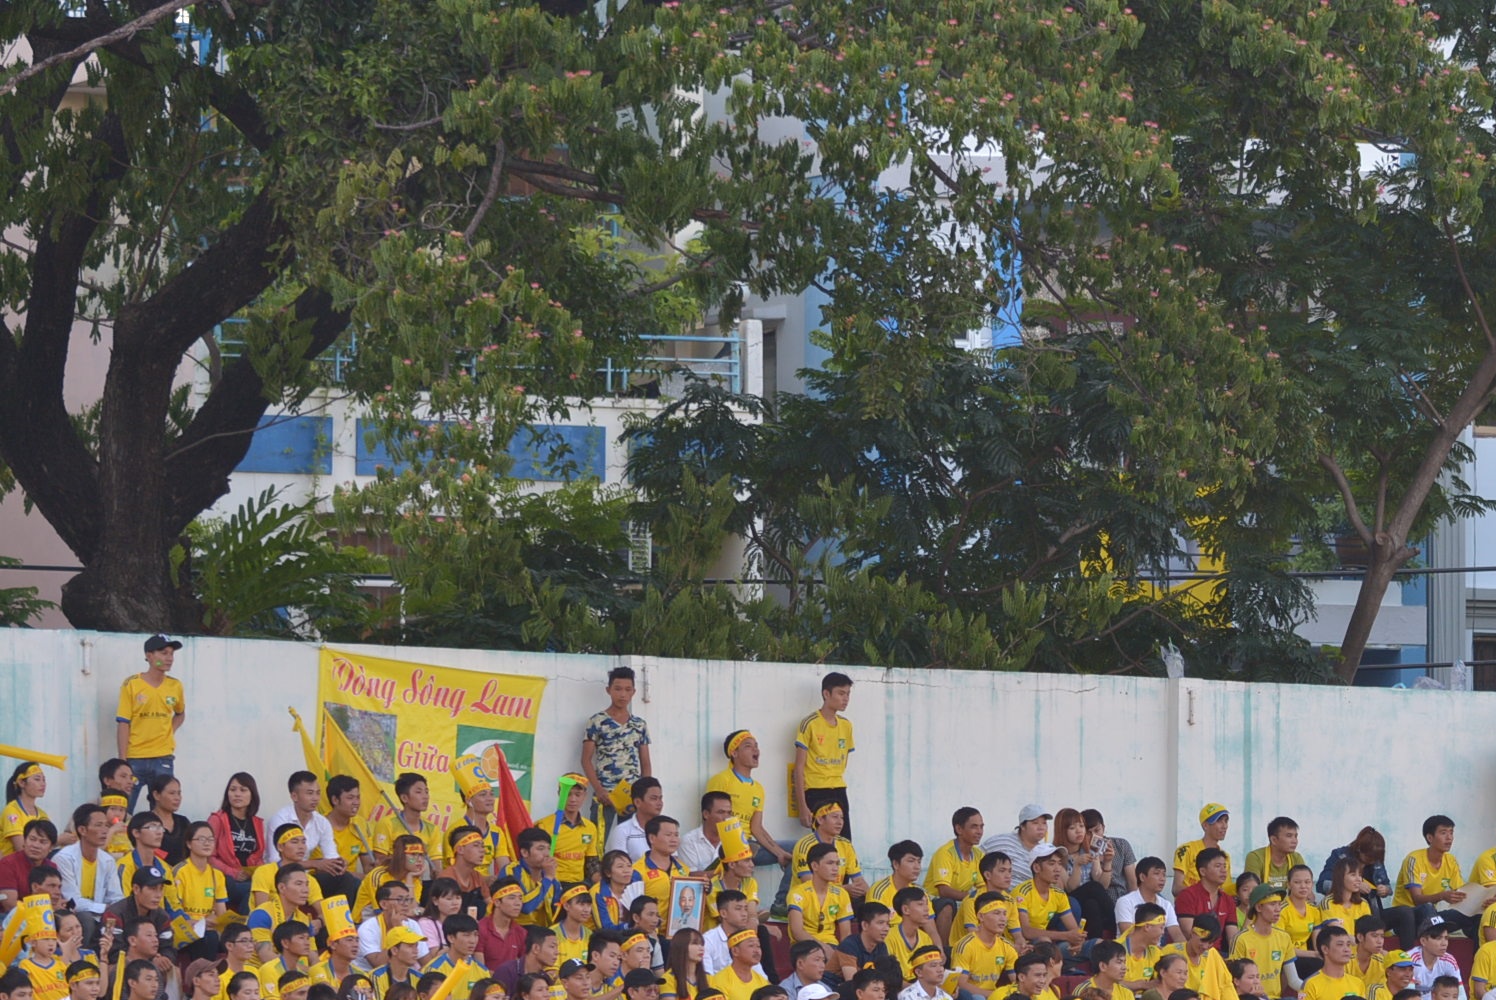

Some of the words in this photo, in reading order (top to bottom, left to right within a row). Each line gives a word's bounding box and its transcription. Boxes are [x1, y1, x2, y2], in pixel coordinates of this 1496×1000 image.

[332, 657, 396, 709] Dòng
[402, 668, 467, 718] Sông
[471, 679, 534, 720] Lam
